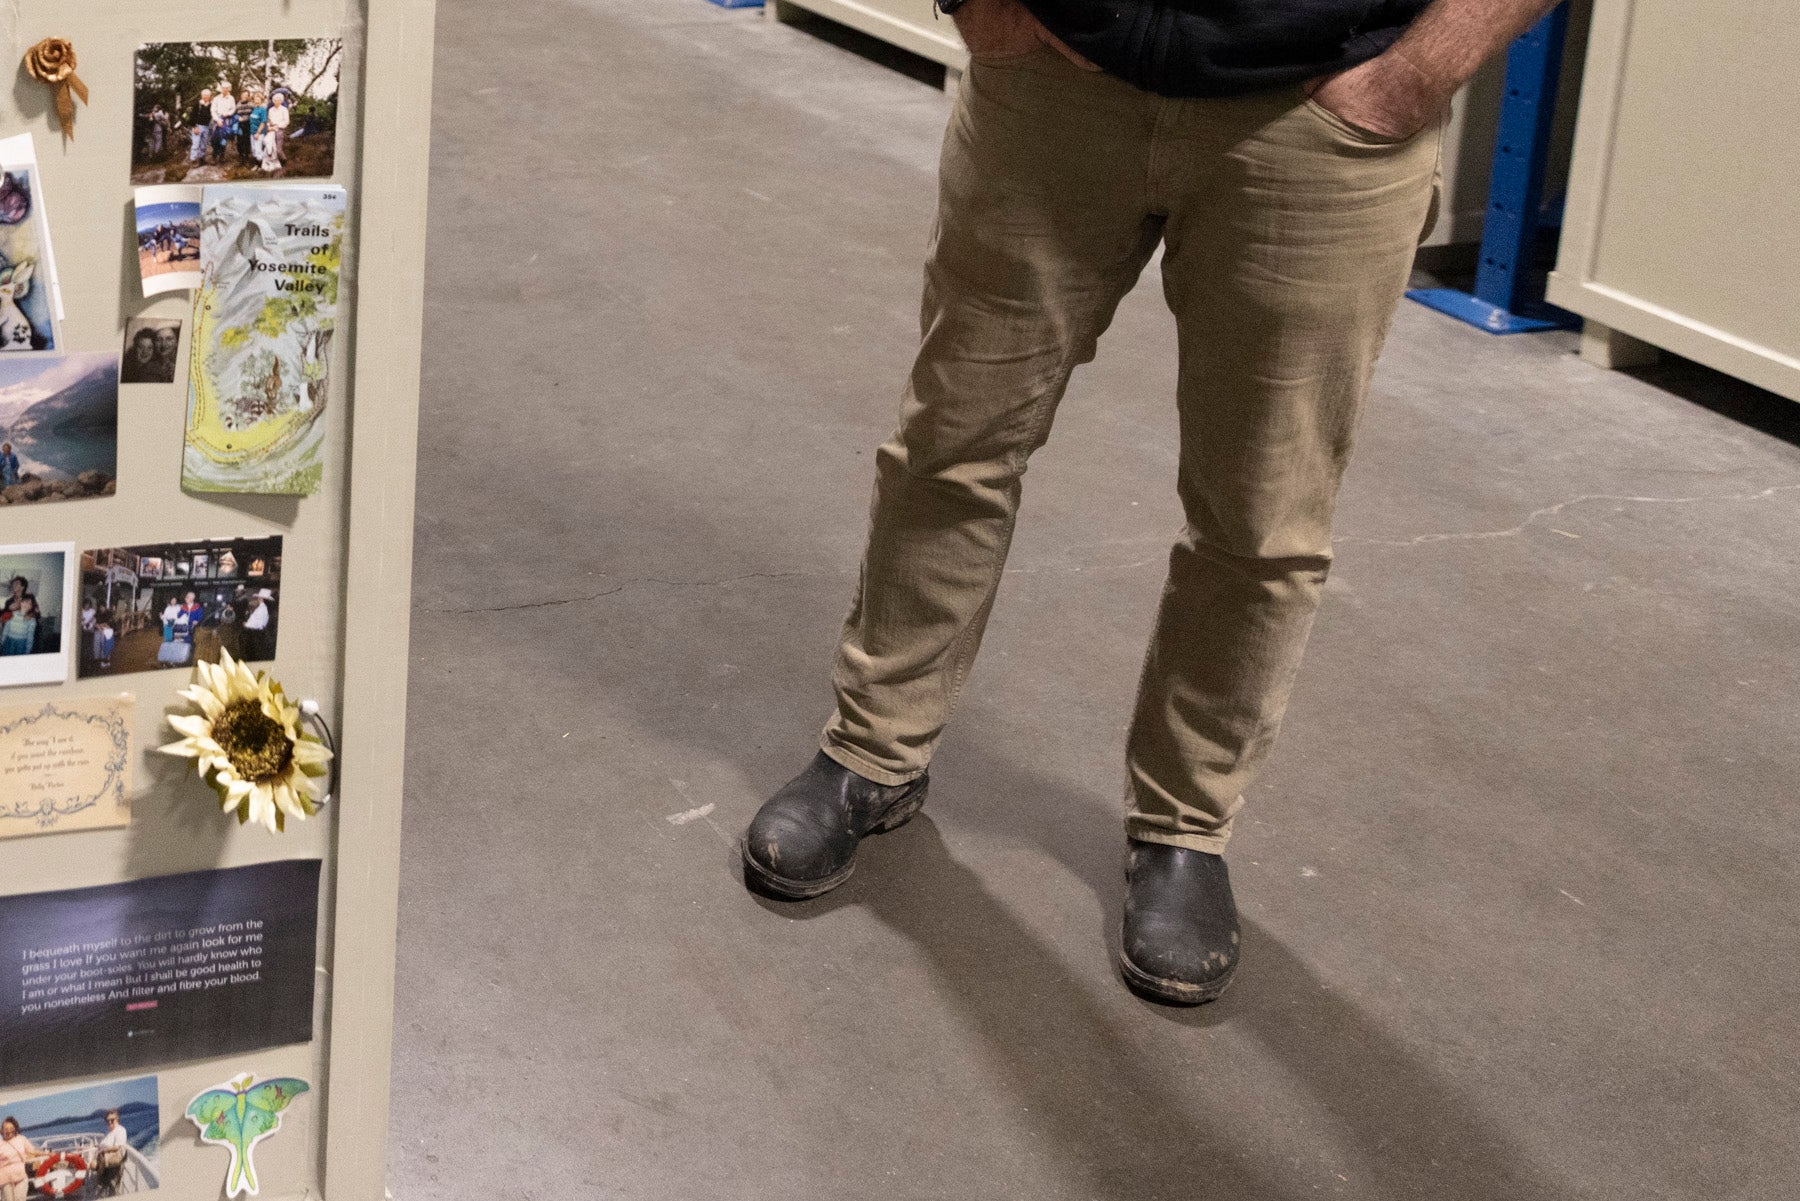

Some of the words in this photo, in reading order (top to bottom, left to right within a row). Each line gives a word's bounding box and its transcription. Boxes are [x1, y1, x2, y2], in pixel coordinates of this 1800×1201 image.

[284, 224, 329, 237] Trails
[310, 243, 329, 255] of
[248, 259, 327, 274] Yosemite
[274, 279, 325, 295] Valley
[22, 962, 50, 975] grass
[60, 958, 83, 968] love
[86, 954, 93, 965] If
[95, 953, 117, 966] you
[120, 948, 146, 959] want
[150, 946, 167, 955] me
[170, 941, 199, 954] again
[202, 936, 225, 948] look
[227, 934, 243, 945] for
[245, 933, 263, 942] me
[29, 943, 80, 959] bequeath
[83, 937, 118, 952] myself
[120, 937, 131, 946] to
[134, 934, 151, 944] the
[154, 931, 172, 941] dirt
[175, 929, 186, 938] to
[188, 926, 216, 938] grow
[218, 922, 244, 933] from
[246, 919, 264, 929] the
[22, 975, 51, 986] under
[54, 971, 77, 983] your
[137, 960, 156, 970] You
[158, 956, 175, 967] will
[178, 952, 208, 964] hardly
[210, 950, 238, 960] know
[240, 946, 263, 956] who
[28, 989, 45, 999] am
[47, 987, 58, 995] or
[61, 982, 86, 994] what
[94, 978, 123, 988] mean
[125, 974, 142, 984] But
[151, 969, 173, 980] shall
[175, 969, 188, 978] be
[190, 963, 216, 978] good
[218, 959, 249, 972] health
[251, 959, 262, 968] to
[21, 1003, 42, 1015] you
[43, 993, 106, 1009] nonetheless
[108, 988, 129, 1000] And
[132, 986, 155, 996] filter
[157, 981, 177, 994] and
[179, 980, 202, 990] fibre
[204, 977, 228, 989] your
